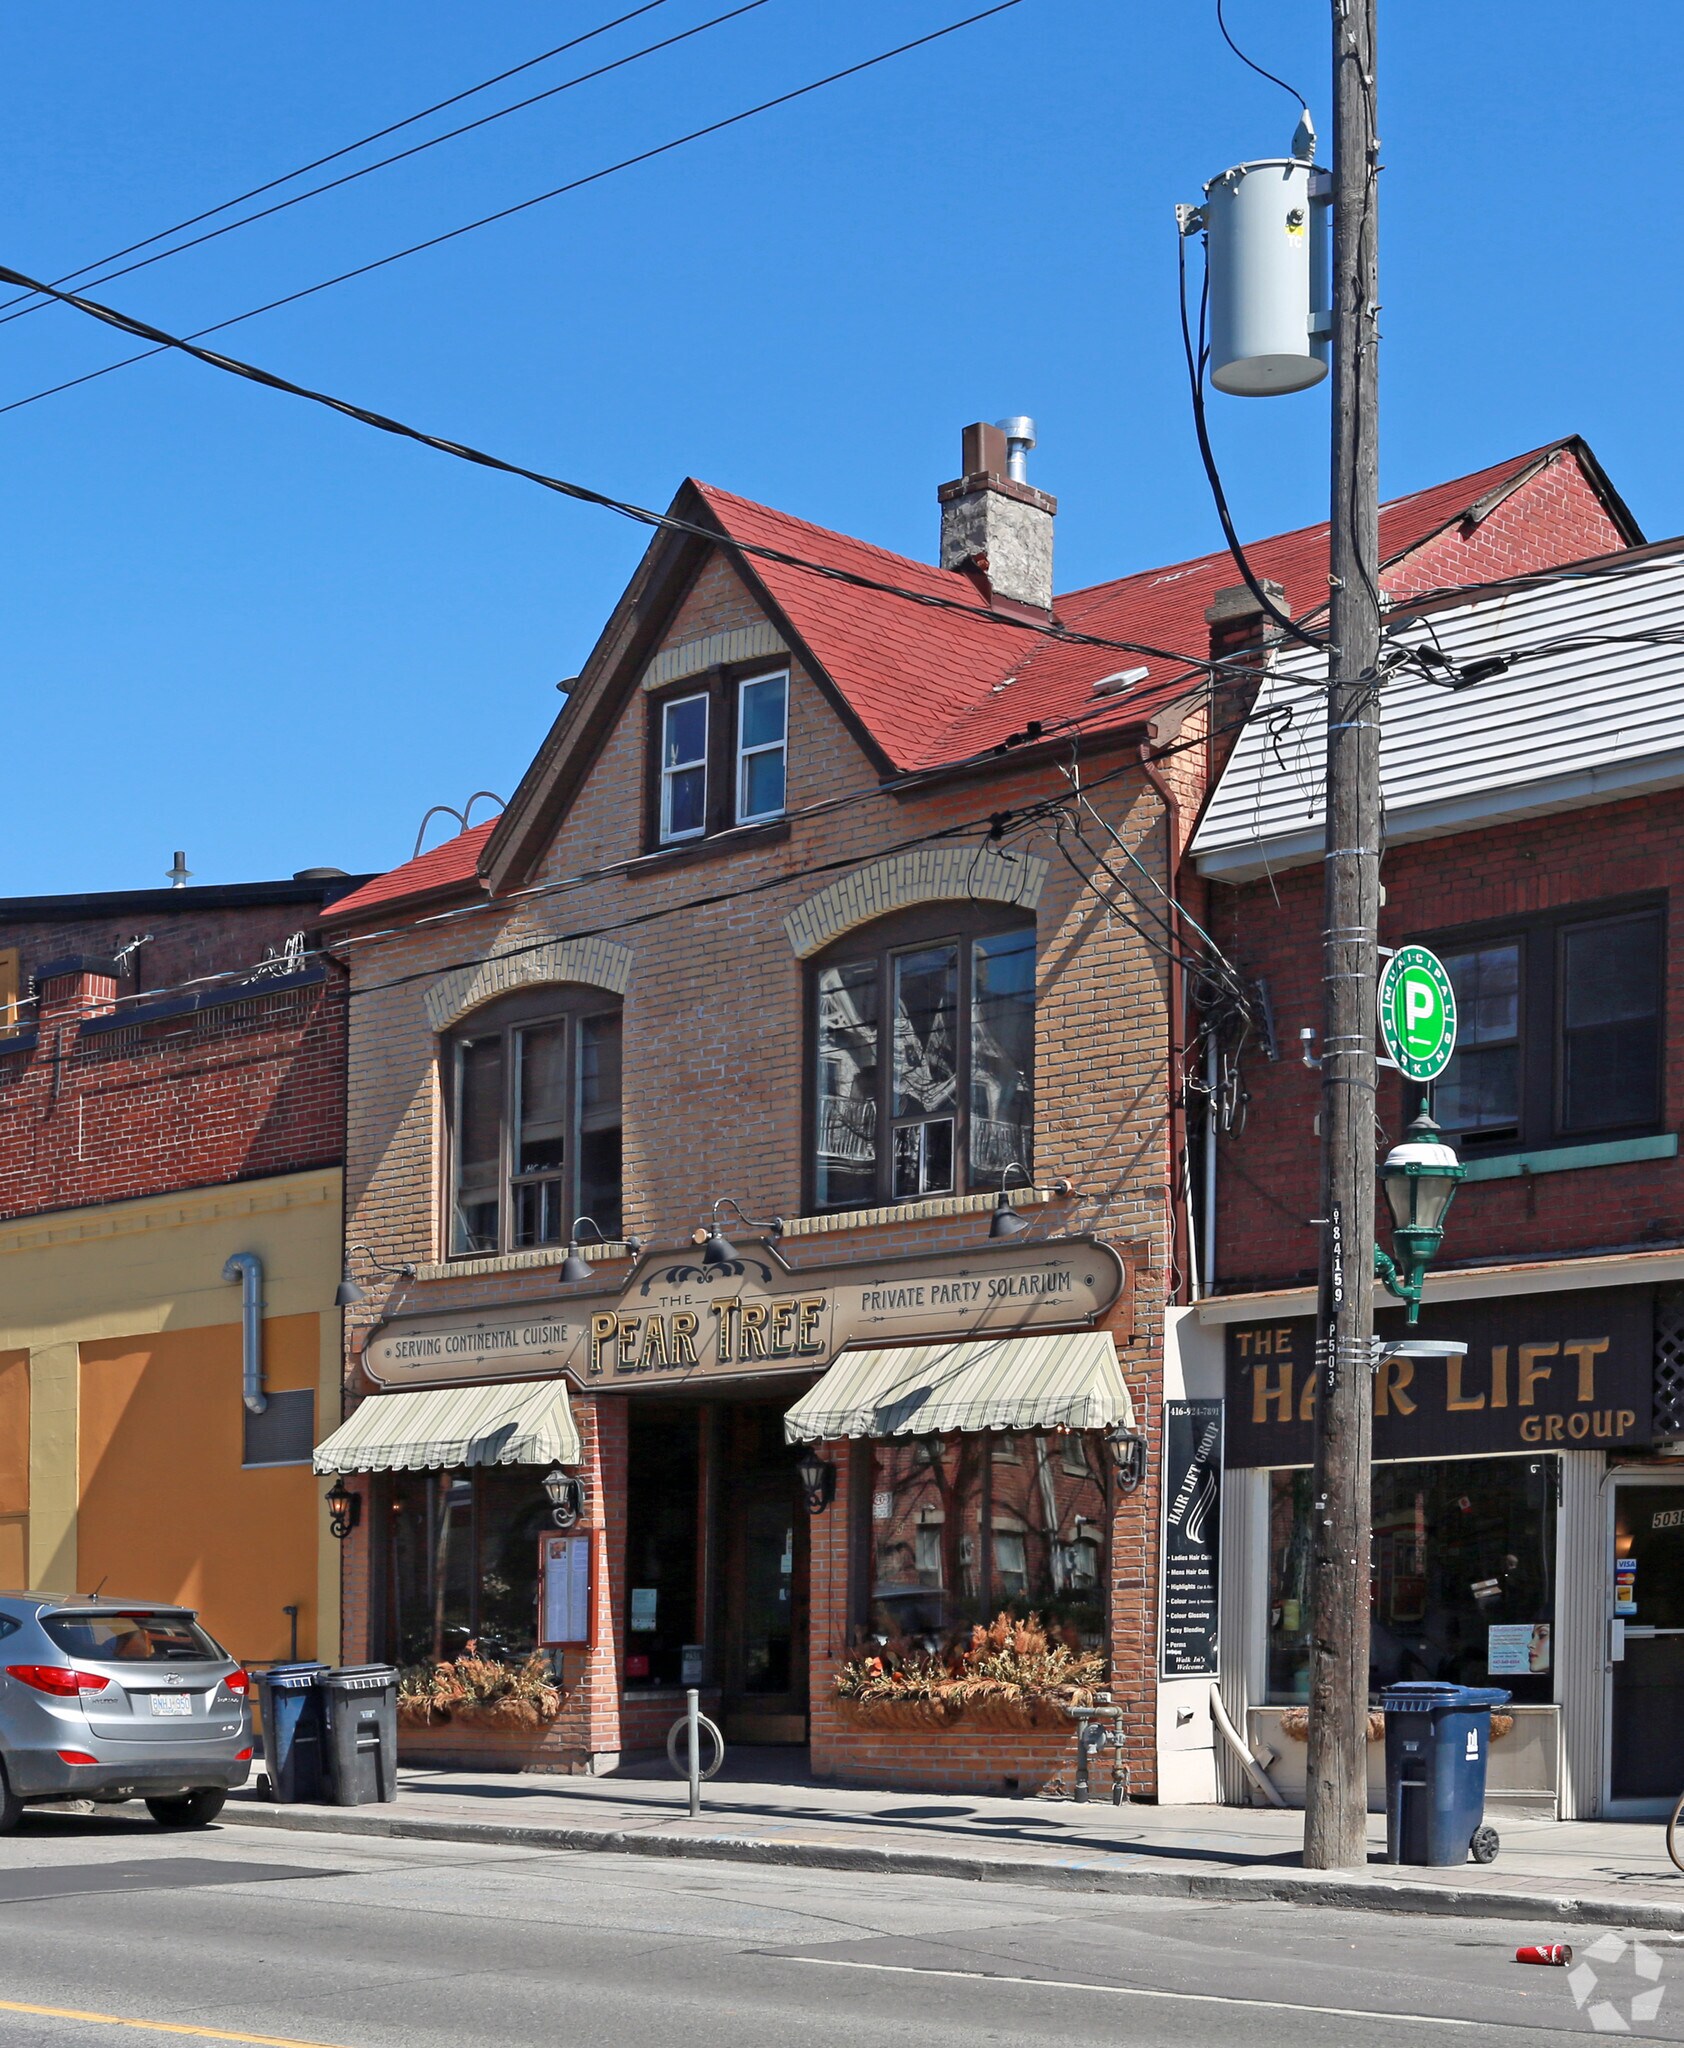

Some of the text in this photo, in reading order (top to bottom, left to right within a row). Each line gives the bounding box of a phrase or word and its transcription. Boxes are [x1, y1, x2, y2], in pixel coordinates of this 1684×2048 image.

[1384, 953, 1452, 1014] MUNICIPAL
[1406, 980, 1434, 1030] P
[1385, 1019, 1452, 1074] PARKING
[659, 1294, 693, 1307] THE
[861, 1271, 1072, 1311] PRIVATE PARTY SOLARIUM
[394, 1324, 568, 1359] SERVING CONTINENTAL CUISINE
[589, 1296, 827, 1371] PEAR TREE
[1236, 1329, 1293, 1357] THE
[1445, 1336, 1610, 1412] LIFT
[1169, 1407, 1220, 1416] 416-924-7891
[1519, 1409, 1636, 1442] GROUP
[1167, 1422, 1220, 1526] HAIR LIFT GROUP
[1618, 1560, 1636, 1568] VISA
[1170, 1583, 1196, 1591] Highlights
